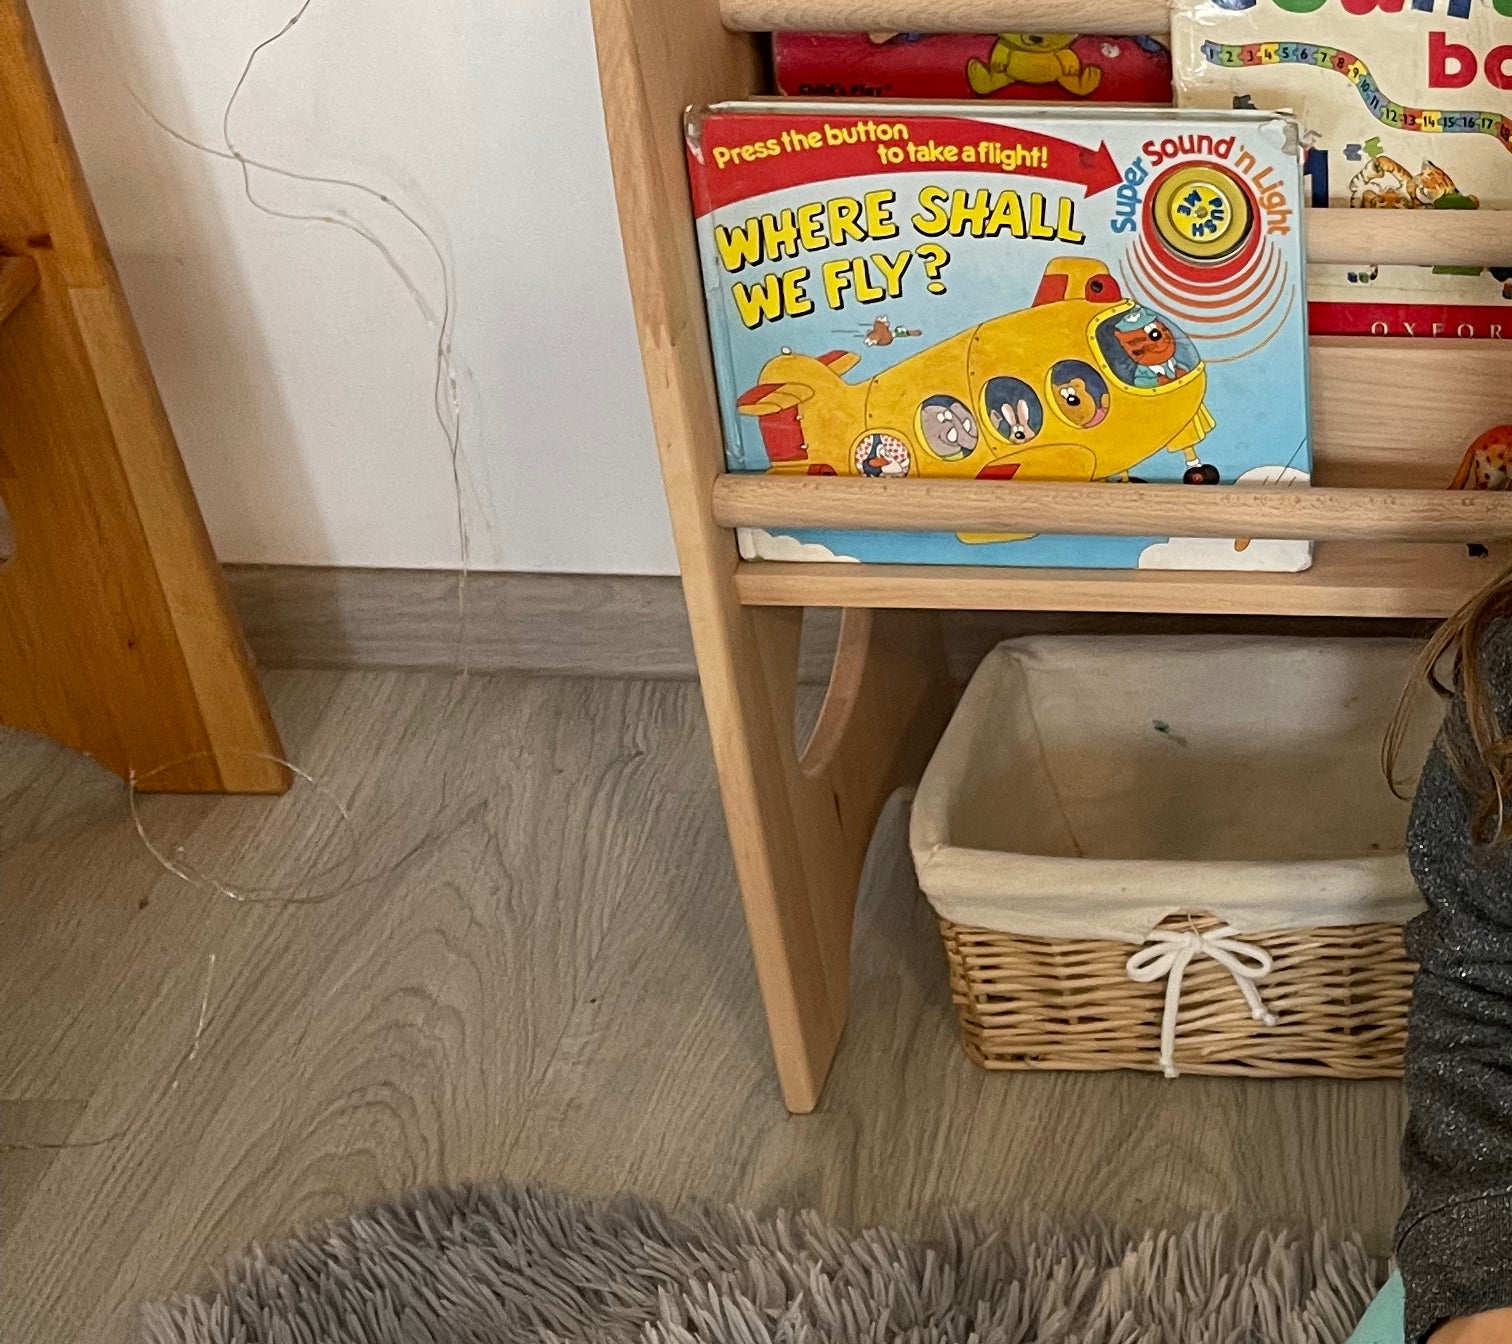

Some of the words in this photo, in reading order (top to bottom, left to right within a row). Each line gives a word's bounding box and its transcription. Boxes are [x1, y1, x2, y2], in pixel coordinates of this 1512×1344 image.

[1360, 78, 1370, 93] 10
[1369, 95, 1379, 109] 11
[1385, 109, 1398, 123] 12
[1402, 113, 1416, 126] 13
[1422, 112, 1435, 128] 14
[1443, 115, 1456, 128] 15
[1462, 115, 1475, 128] 16
[1481, 116, 1494, 130] 17
[712, 137, 782, 169] Press
[780, 130, 823, 153] the
[824, 119, 909, 147] button
[876, 143, 905, 166] to
[906, 140, 959, 164] take
[961, 144, 977, 164] a
[977, 141, 1049, 172] flight!
[1110, 155, 1149, 235] Super
[1142, 133, 1237, 168] Sound
[1252, 166, 1293, 237] Light
[1176, 189, 1203, 217] ME
[713, 188, 900, 274] WHERE
[911, 185, 1087, 246] SHALL
[1192, 196, 1225, 238] PUSH
[731, 266, 816, 330] WE
[822, 242, 952, 311] FLY?
